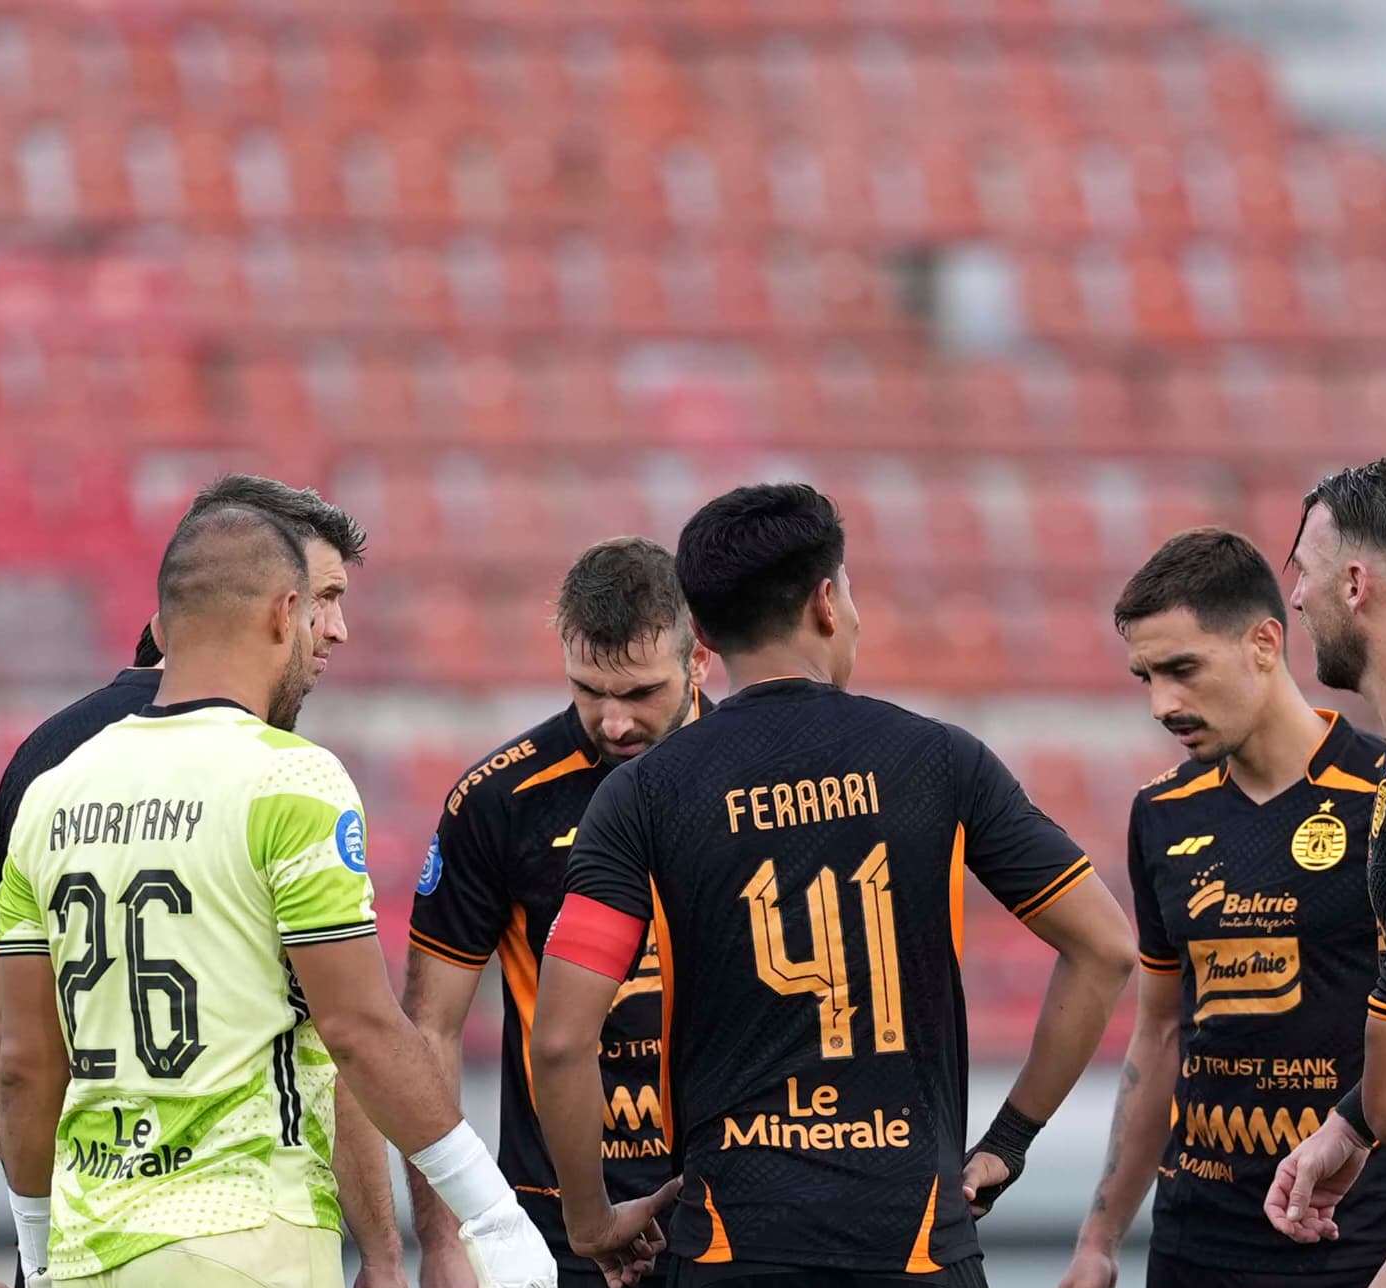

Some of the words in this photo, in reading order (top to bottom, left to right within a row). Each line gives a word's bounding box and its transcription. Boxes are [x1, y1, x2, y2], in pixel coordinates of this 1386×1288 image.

[725, 771, 880, 834] FERARRI
[49, 797, 203, 852] ANDRITANY
[1222, 891, 1299, 915] Bakrie
[739, 840, 908, 1061] 41
[47, 868, 209, 1079] 26
[1204, 1058, 1266, 1076] TRUST
[1272, 1057, 1338, 1076] BANK
[787, 1076, 840, 1118] Le
[112, 1106, 153, 1149] Le
[600, 1138, 671, 1160] MMAN
[720, 1108, 910, 1151] Minerale
